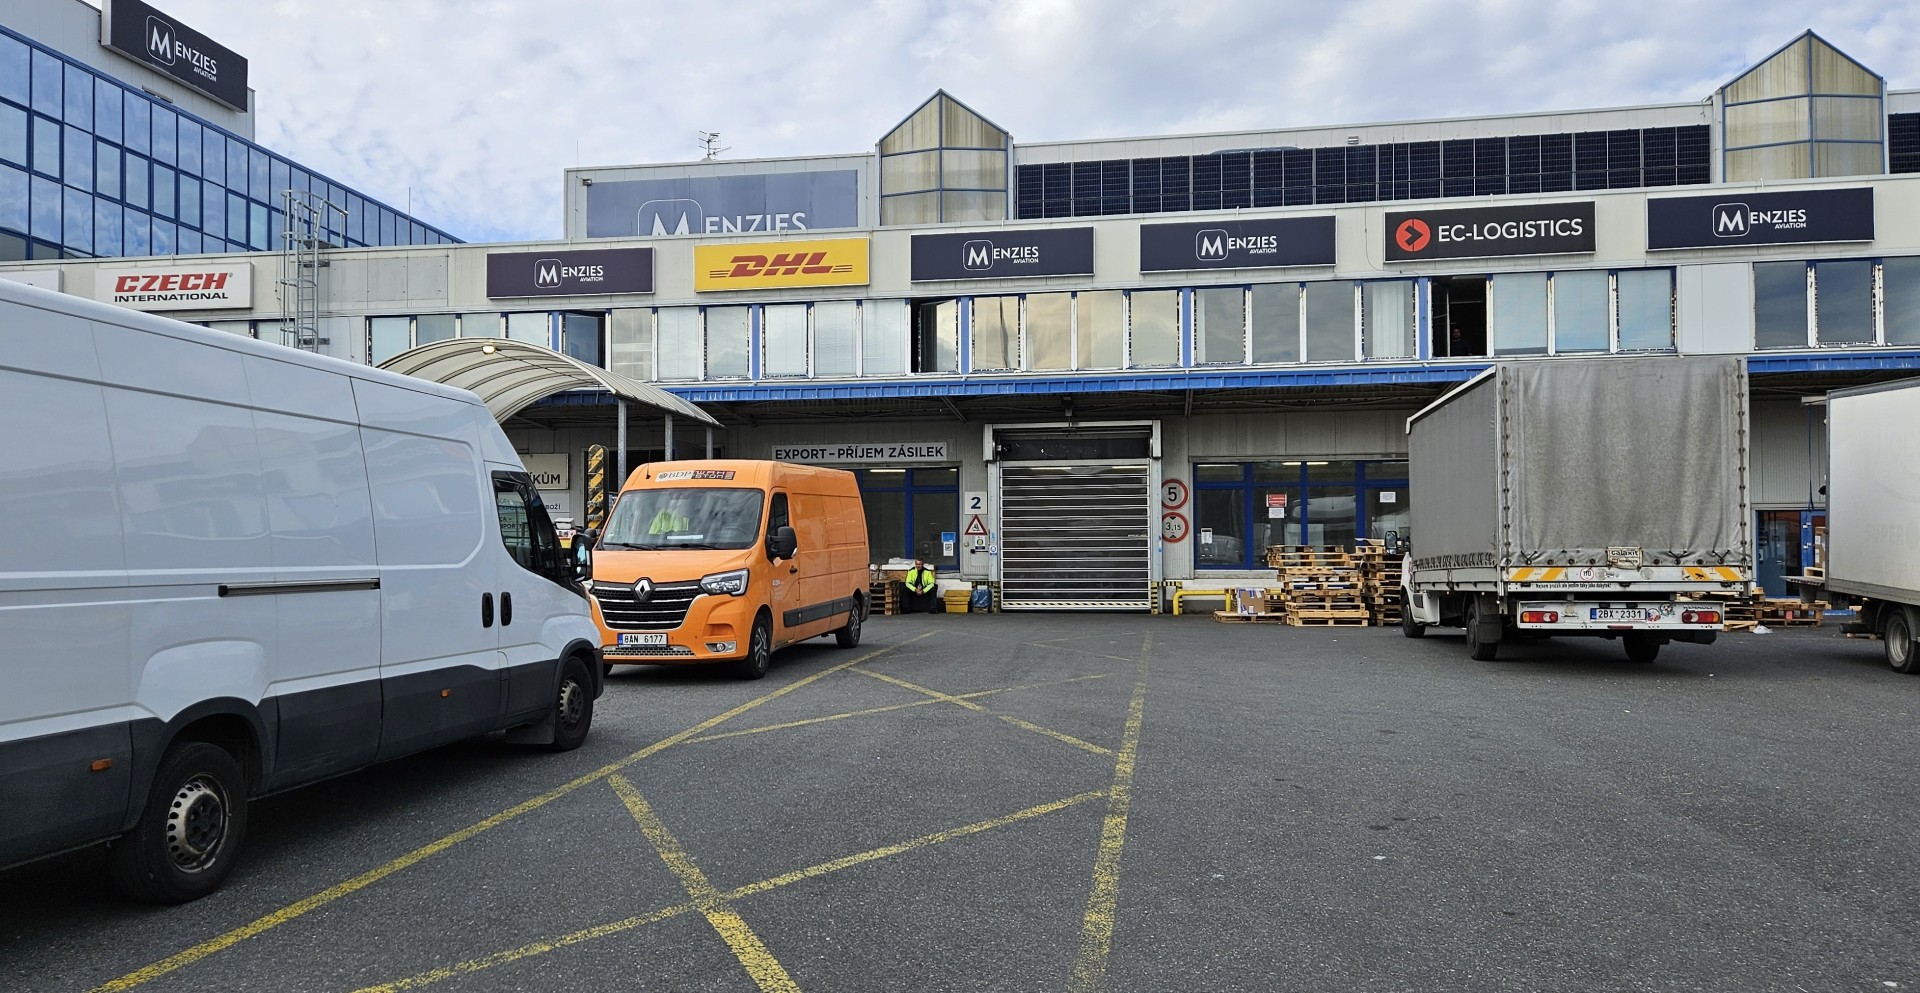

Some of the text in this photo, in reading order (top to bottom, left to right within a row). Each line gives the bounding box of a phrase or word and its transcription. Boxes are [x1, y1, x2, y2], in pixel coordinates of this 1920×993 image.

[150, 24, 217, 75] MENZIES
[193, 65, 217, 82] AVIATION
[1718, 208, 1807, 232] MENZIES
[1774, 221, 1807, 229] AVIATION
[1438, 218, 1583, 242] EC-LOGISTICS
[1200, 235, 1278, 256] MENZIES
[729, 251, 834, 278] DHL
[967, 245, 1039, 266] MENZIES
[114, 272, 228, 293] CZECH
[538, 264, 604, 284] MENZIES
[114, 291, 228, 303] INTERNATIONAL
[775, 448, 827, 460] EXPORT
[837, 445, 884, 459] PŘÍJEM
[888, 444, 944, 458] ZÁSILEK
[970, 496, 981, 509] 2
[1167, 486, 1177, 502] 5
[1598, 610, 1641, 618] 2BX 2331
[624, 635, 663, 643] 8AN 6177
